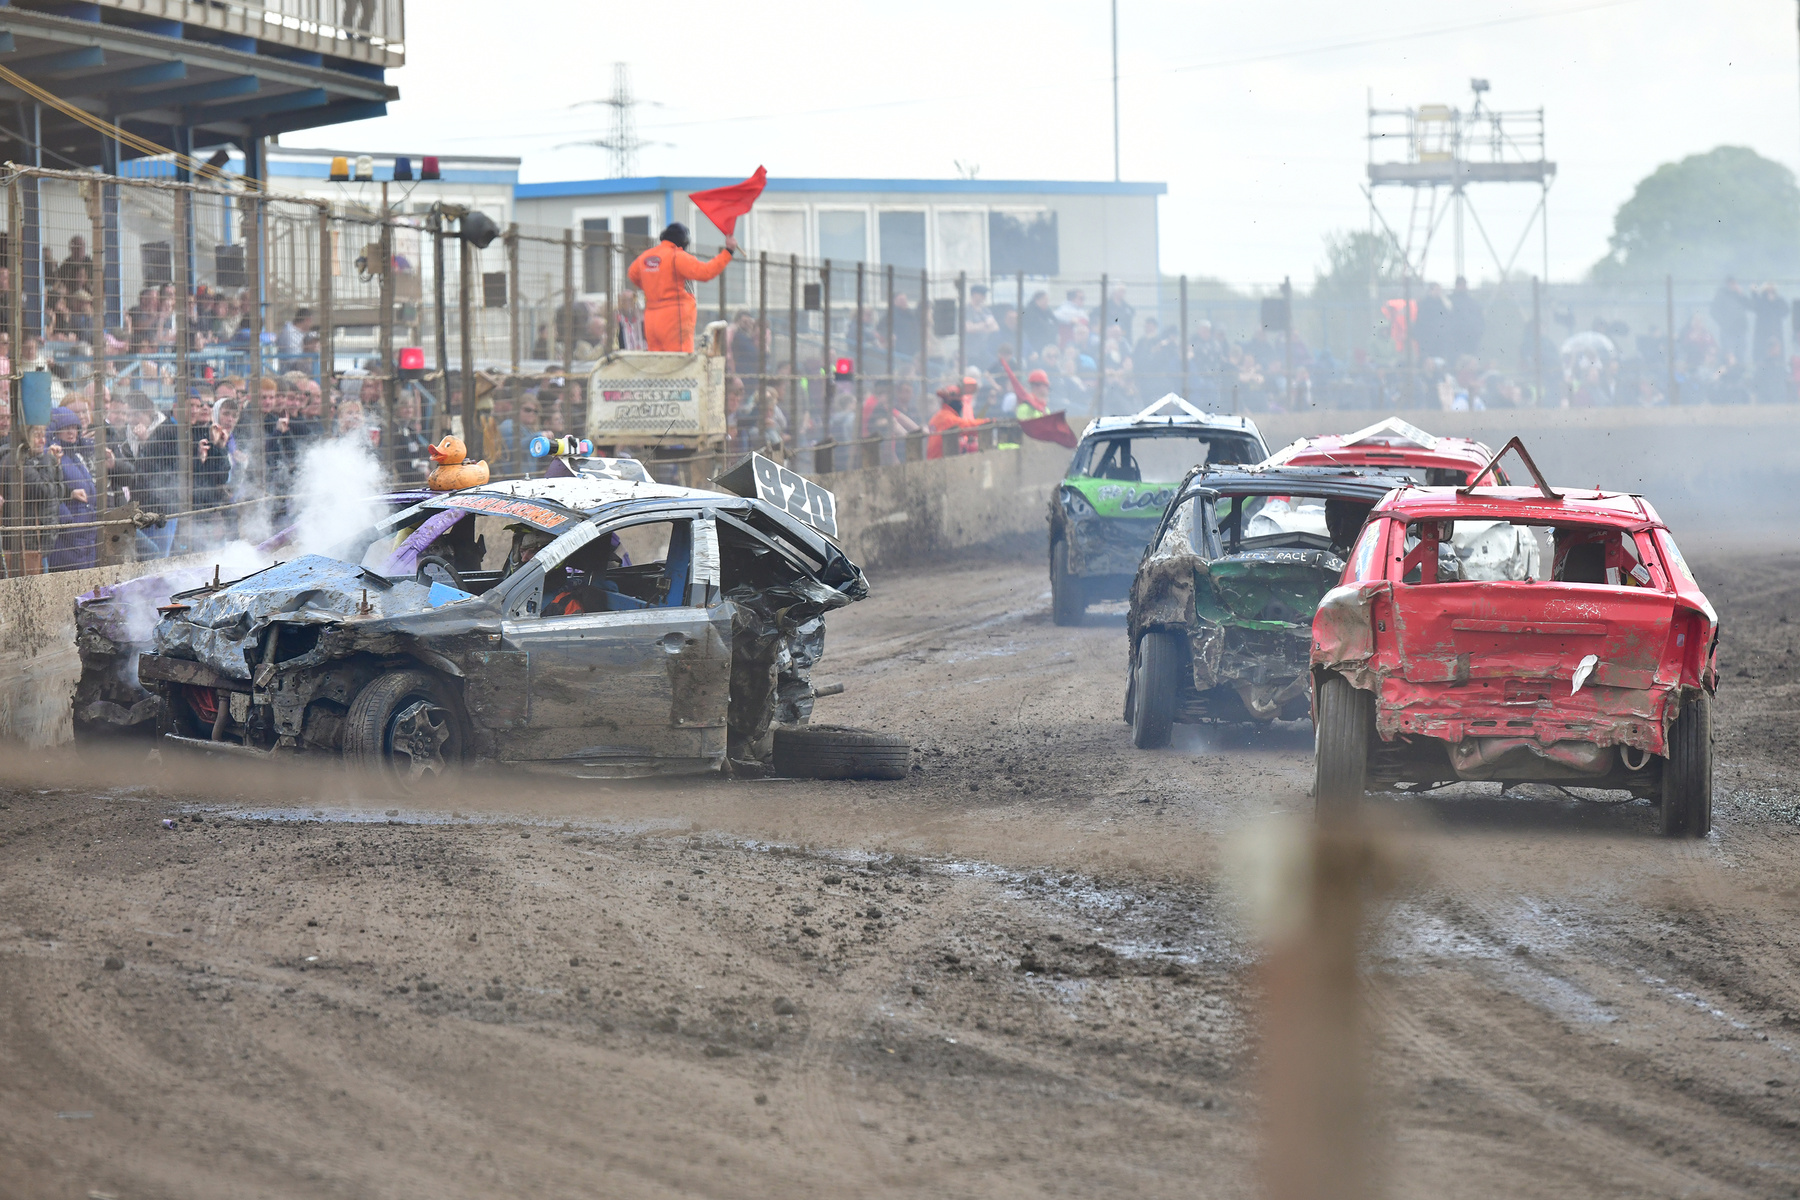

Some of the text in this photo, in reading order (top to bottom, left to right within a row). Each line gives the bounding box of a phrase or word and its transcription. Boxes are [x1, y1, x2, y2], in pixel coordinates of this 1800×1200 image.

[603, 389, 692, 403] TRACKSTAR
[615, 403, 681, 420] RACING
[754, 454, 837, 538] 920
[1120, 486, 1179, 512] LOC
[1276, 552, 1307, 562] RACE
